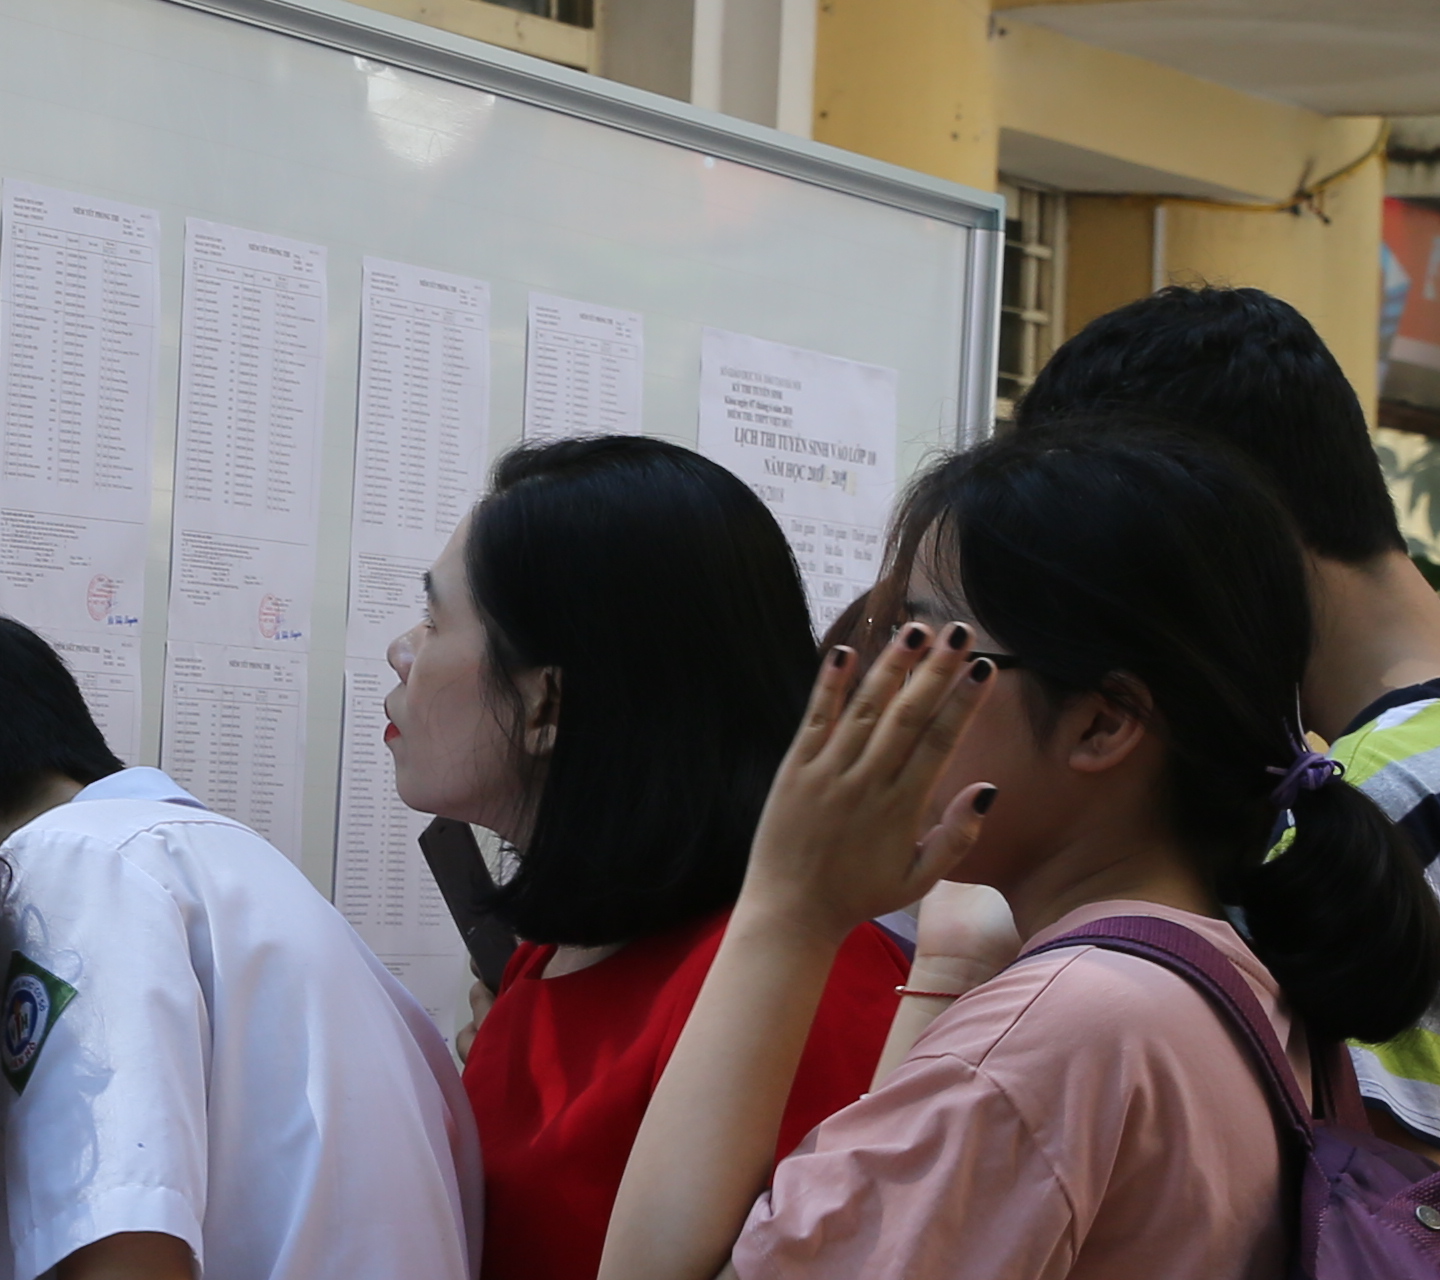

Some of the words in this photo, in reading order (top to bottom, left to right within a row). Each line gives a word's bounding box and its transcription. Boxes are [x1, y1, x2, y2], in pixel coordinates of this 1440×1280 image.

[734, 426, 758, 447] LỊCH
[760, 431, 776, 448] THI
[778, 432, 807, 454] TUYỂN
[808, 439, 829, 458] SINH
[831, 440, 848, 461] VÀO
[849, 443, 866, 464] LỚP
[867, 450, 877, 466] 10
[764, 455, 785, 478] NĂM
[786, 462, 805, 483] HỌC
